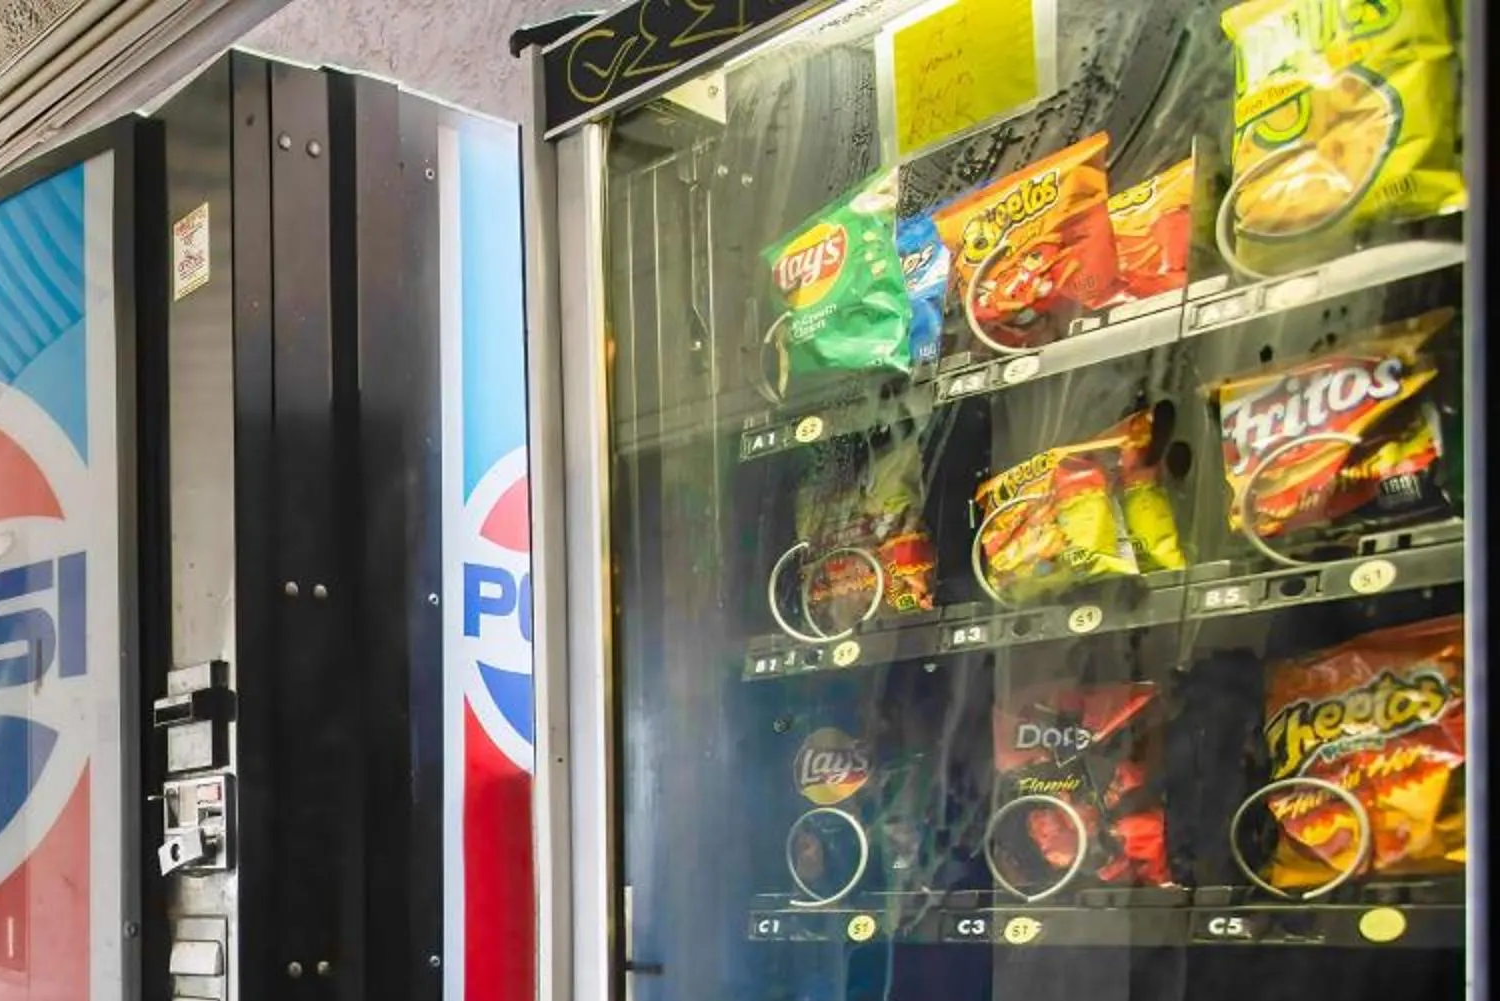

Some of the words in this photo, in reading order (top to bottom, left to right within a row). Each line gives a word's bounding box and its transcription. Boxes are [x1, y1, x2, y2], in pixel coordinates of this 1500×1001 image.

[1222, 359, 1402, 476] Fritos
[752, 432, 775, 450] A1
[1205, 586, 1242, 607] B5
[953, 626, 982, 644] B3
[1264, 667, 1448, 780] Cheetos
[757, 919, 780, 935] C1
[957, 919, 986, 935] C3
[1207, 917, 1245, 936] C5
